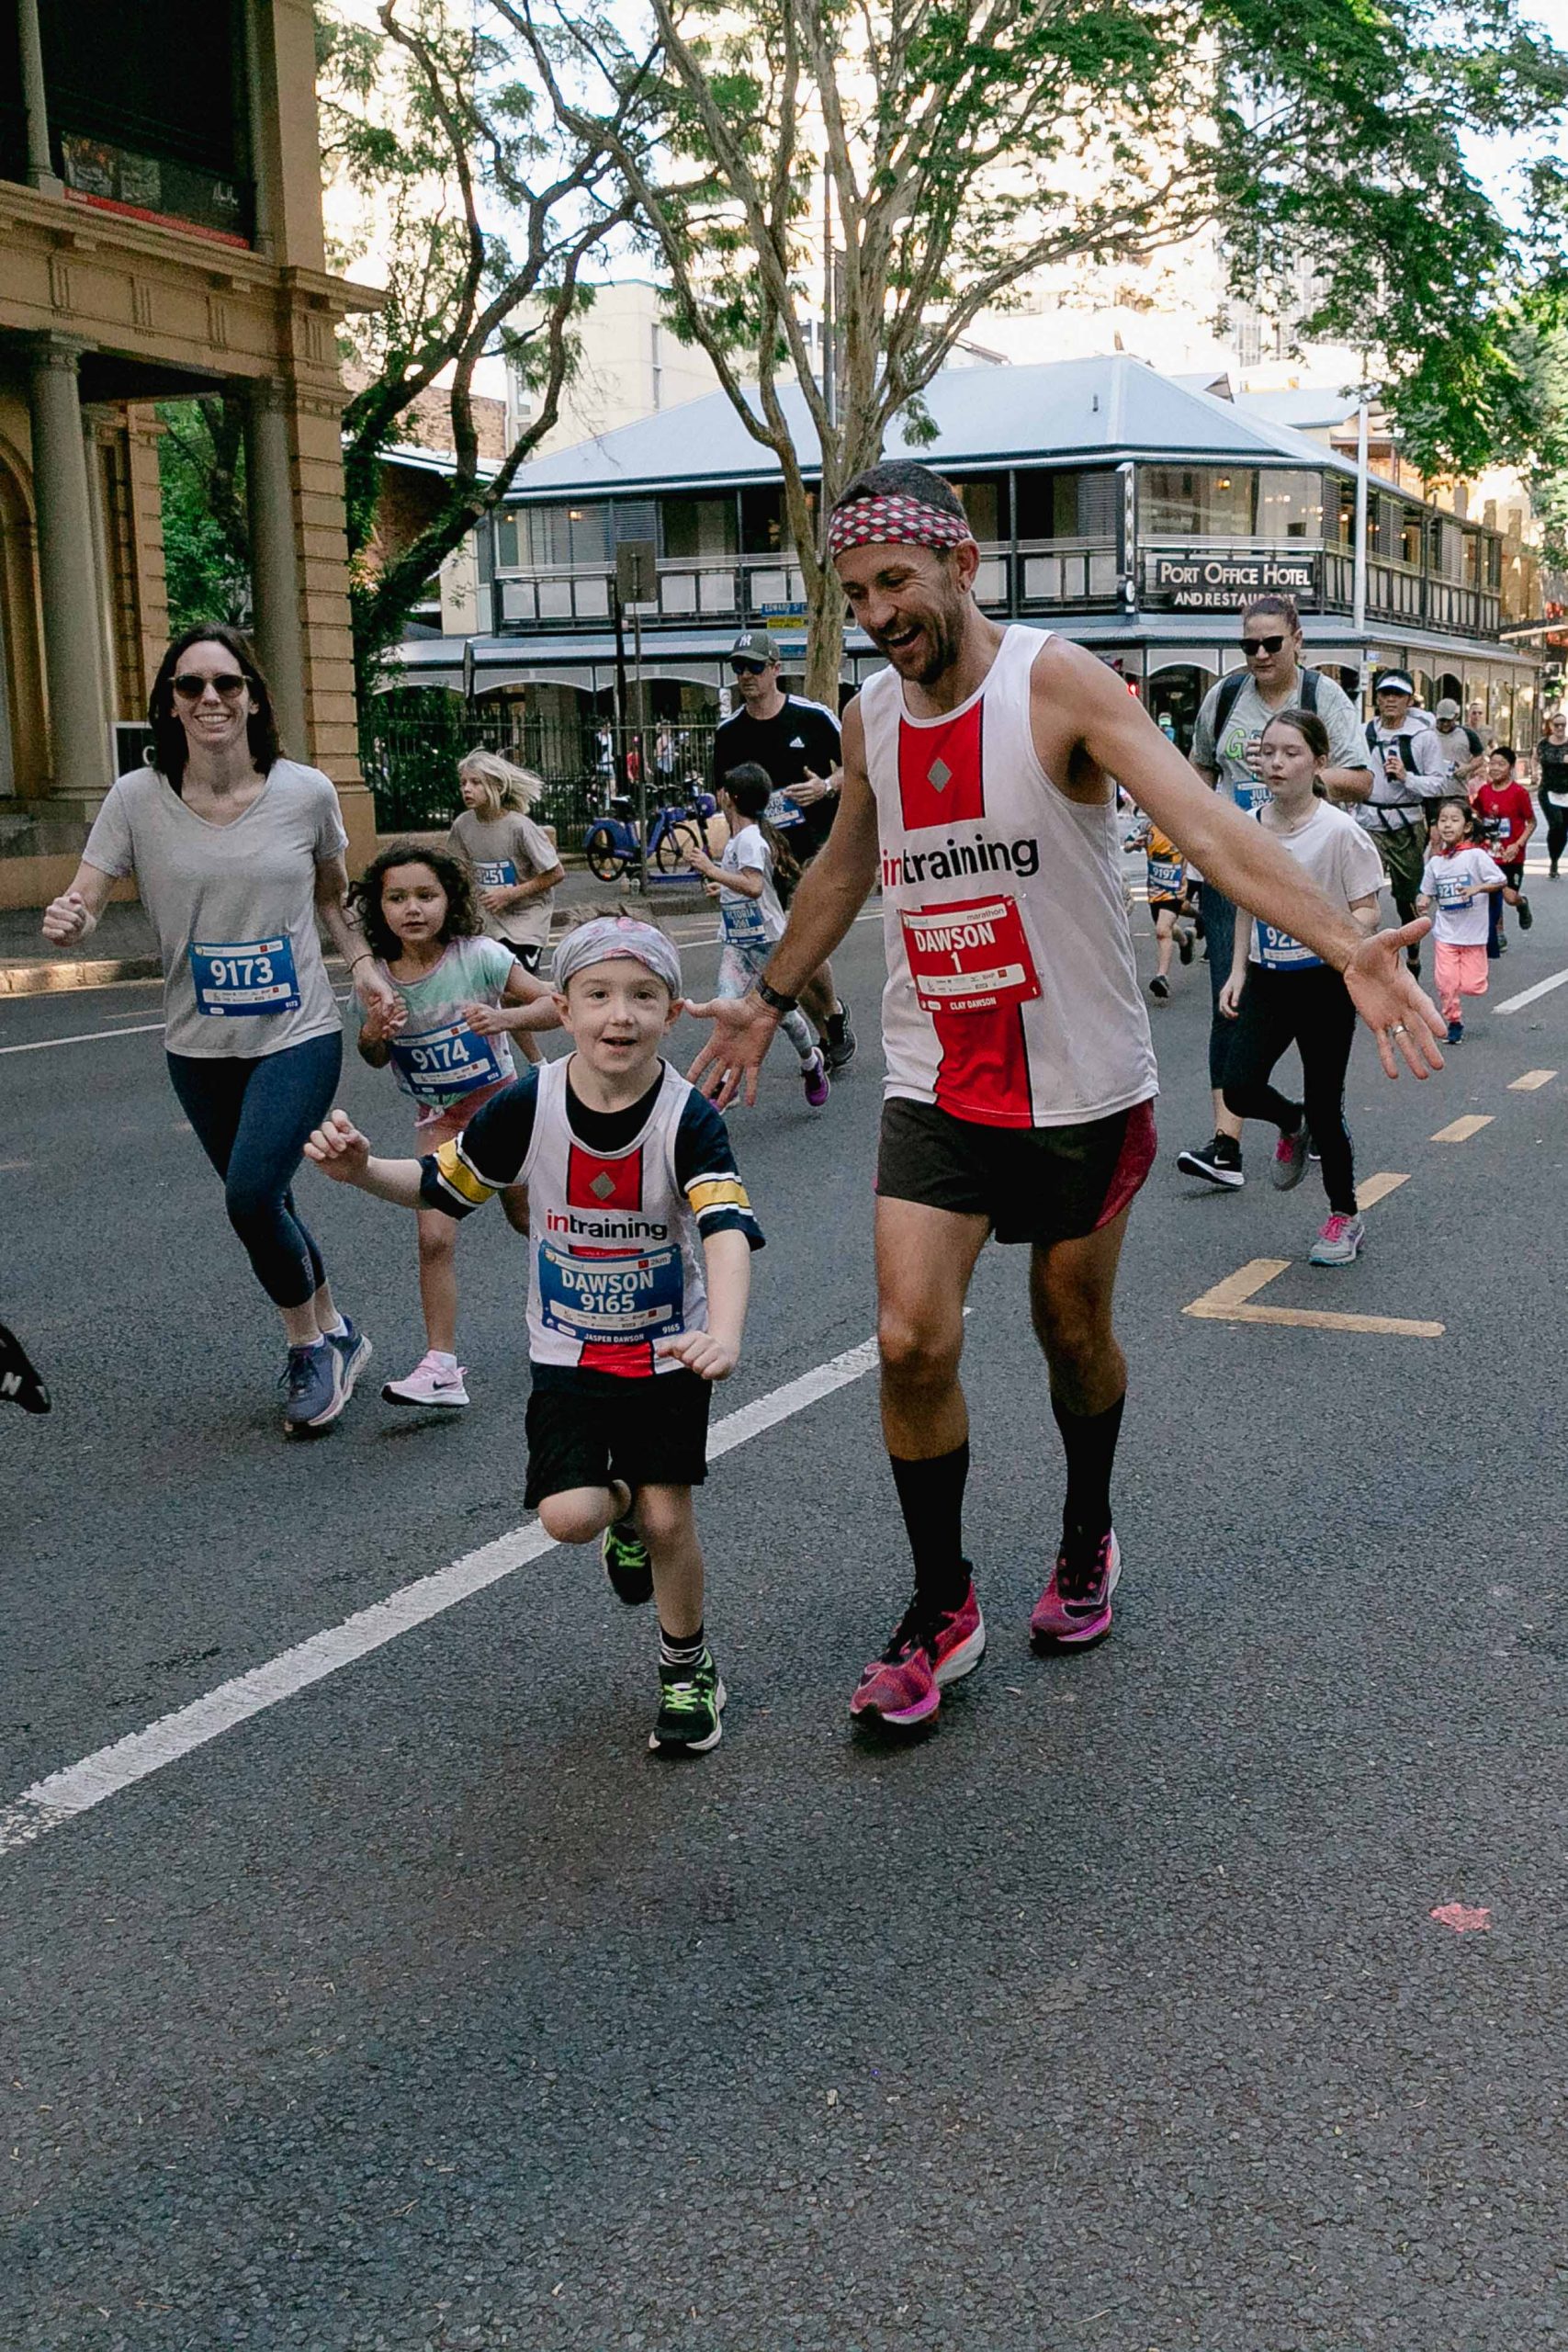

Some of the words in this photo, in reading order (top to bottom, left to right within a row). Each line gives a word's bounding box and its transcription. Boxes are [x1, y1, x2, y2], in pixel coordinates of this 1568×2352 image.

[1160, 561, 1200, 584] PORT
[1204, 561, 1258, 585] OFFICE
[1263, 563, 1311, 586] HOTEL
[1174, 592, 1203, 606] AND
[1204, 592, 1296, 606] RESTAUT
[1250, 788, 1274, 801] JULI
[883, 833, 1040, 887] intraining
[1153, 866, 1177, 880] 9197
[966, 907, 1004, 921] marathon
[914, 922, 996, 953] DAWSON
[210, 956, 274, 987] 9173
[950, 951, 963, 974] 1
[950, 1001, 966, 1011] CLAY
[966, 996, 997, 1009] DAWSON
[410, 1037, 470, 1070] 9174
[546, 1209, 668, 1241] intraining
[560, 1269, 654, 1294] DAWSON
[580, 1294, 636, 1314] 9165
[583, 1333, 612, 1343] JASPER
[614, 1333, 645, 1343] DAWSON
[662, 1323, 681, 1335] 9165
